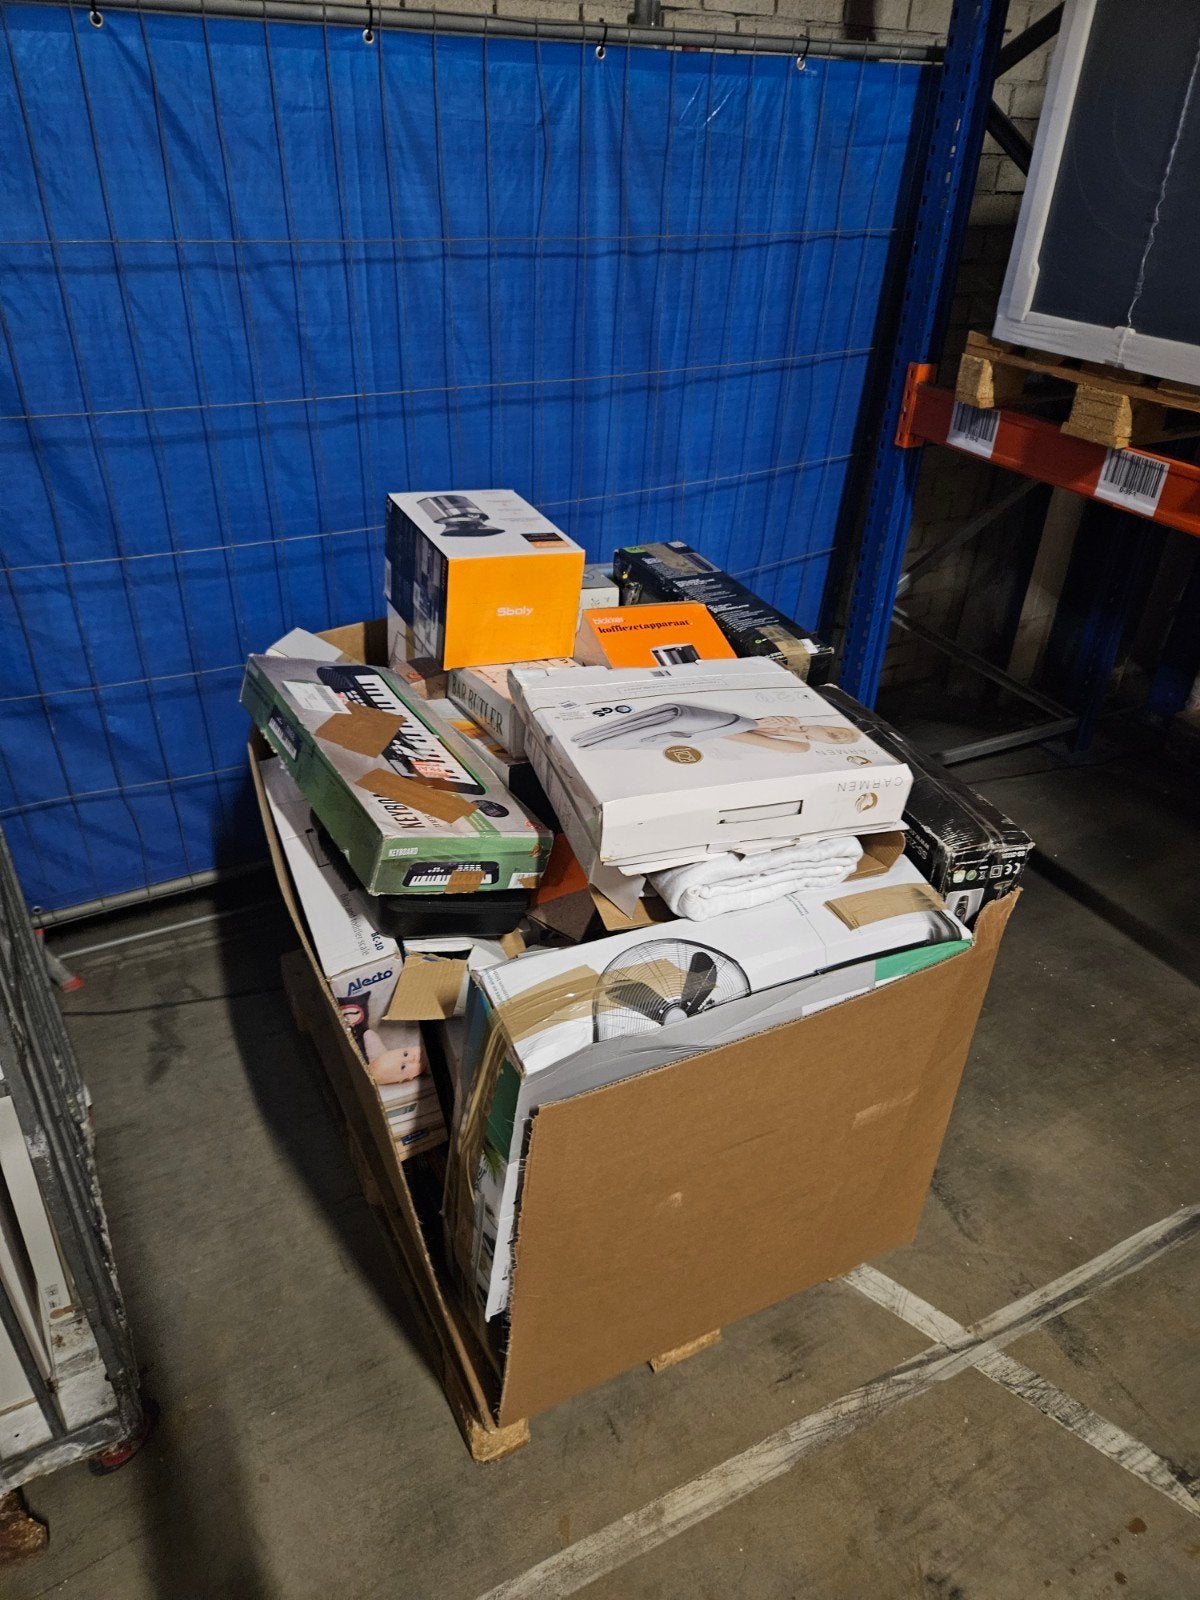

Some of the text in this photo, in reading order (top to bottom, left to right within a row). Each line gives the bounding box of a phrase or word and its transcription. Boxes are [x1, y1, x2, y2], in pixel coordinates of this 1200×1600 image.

[496, 605, 534, 617] Sboly
[451, 673, 504, 737] BAR BUTLER
[592, 706, 613, 717] GS
[815, 748, 879, 756] CARMEN
[837, 776, 904, 792] CARMEN
[373, 793, 426, 829] KEYBO
[388, 846, 419, 857] KEYBOARD
[370, 930, 384, 951] BC-10
[347, 969, 393, 997] Alecto
